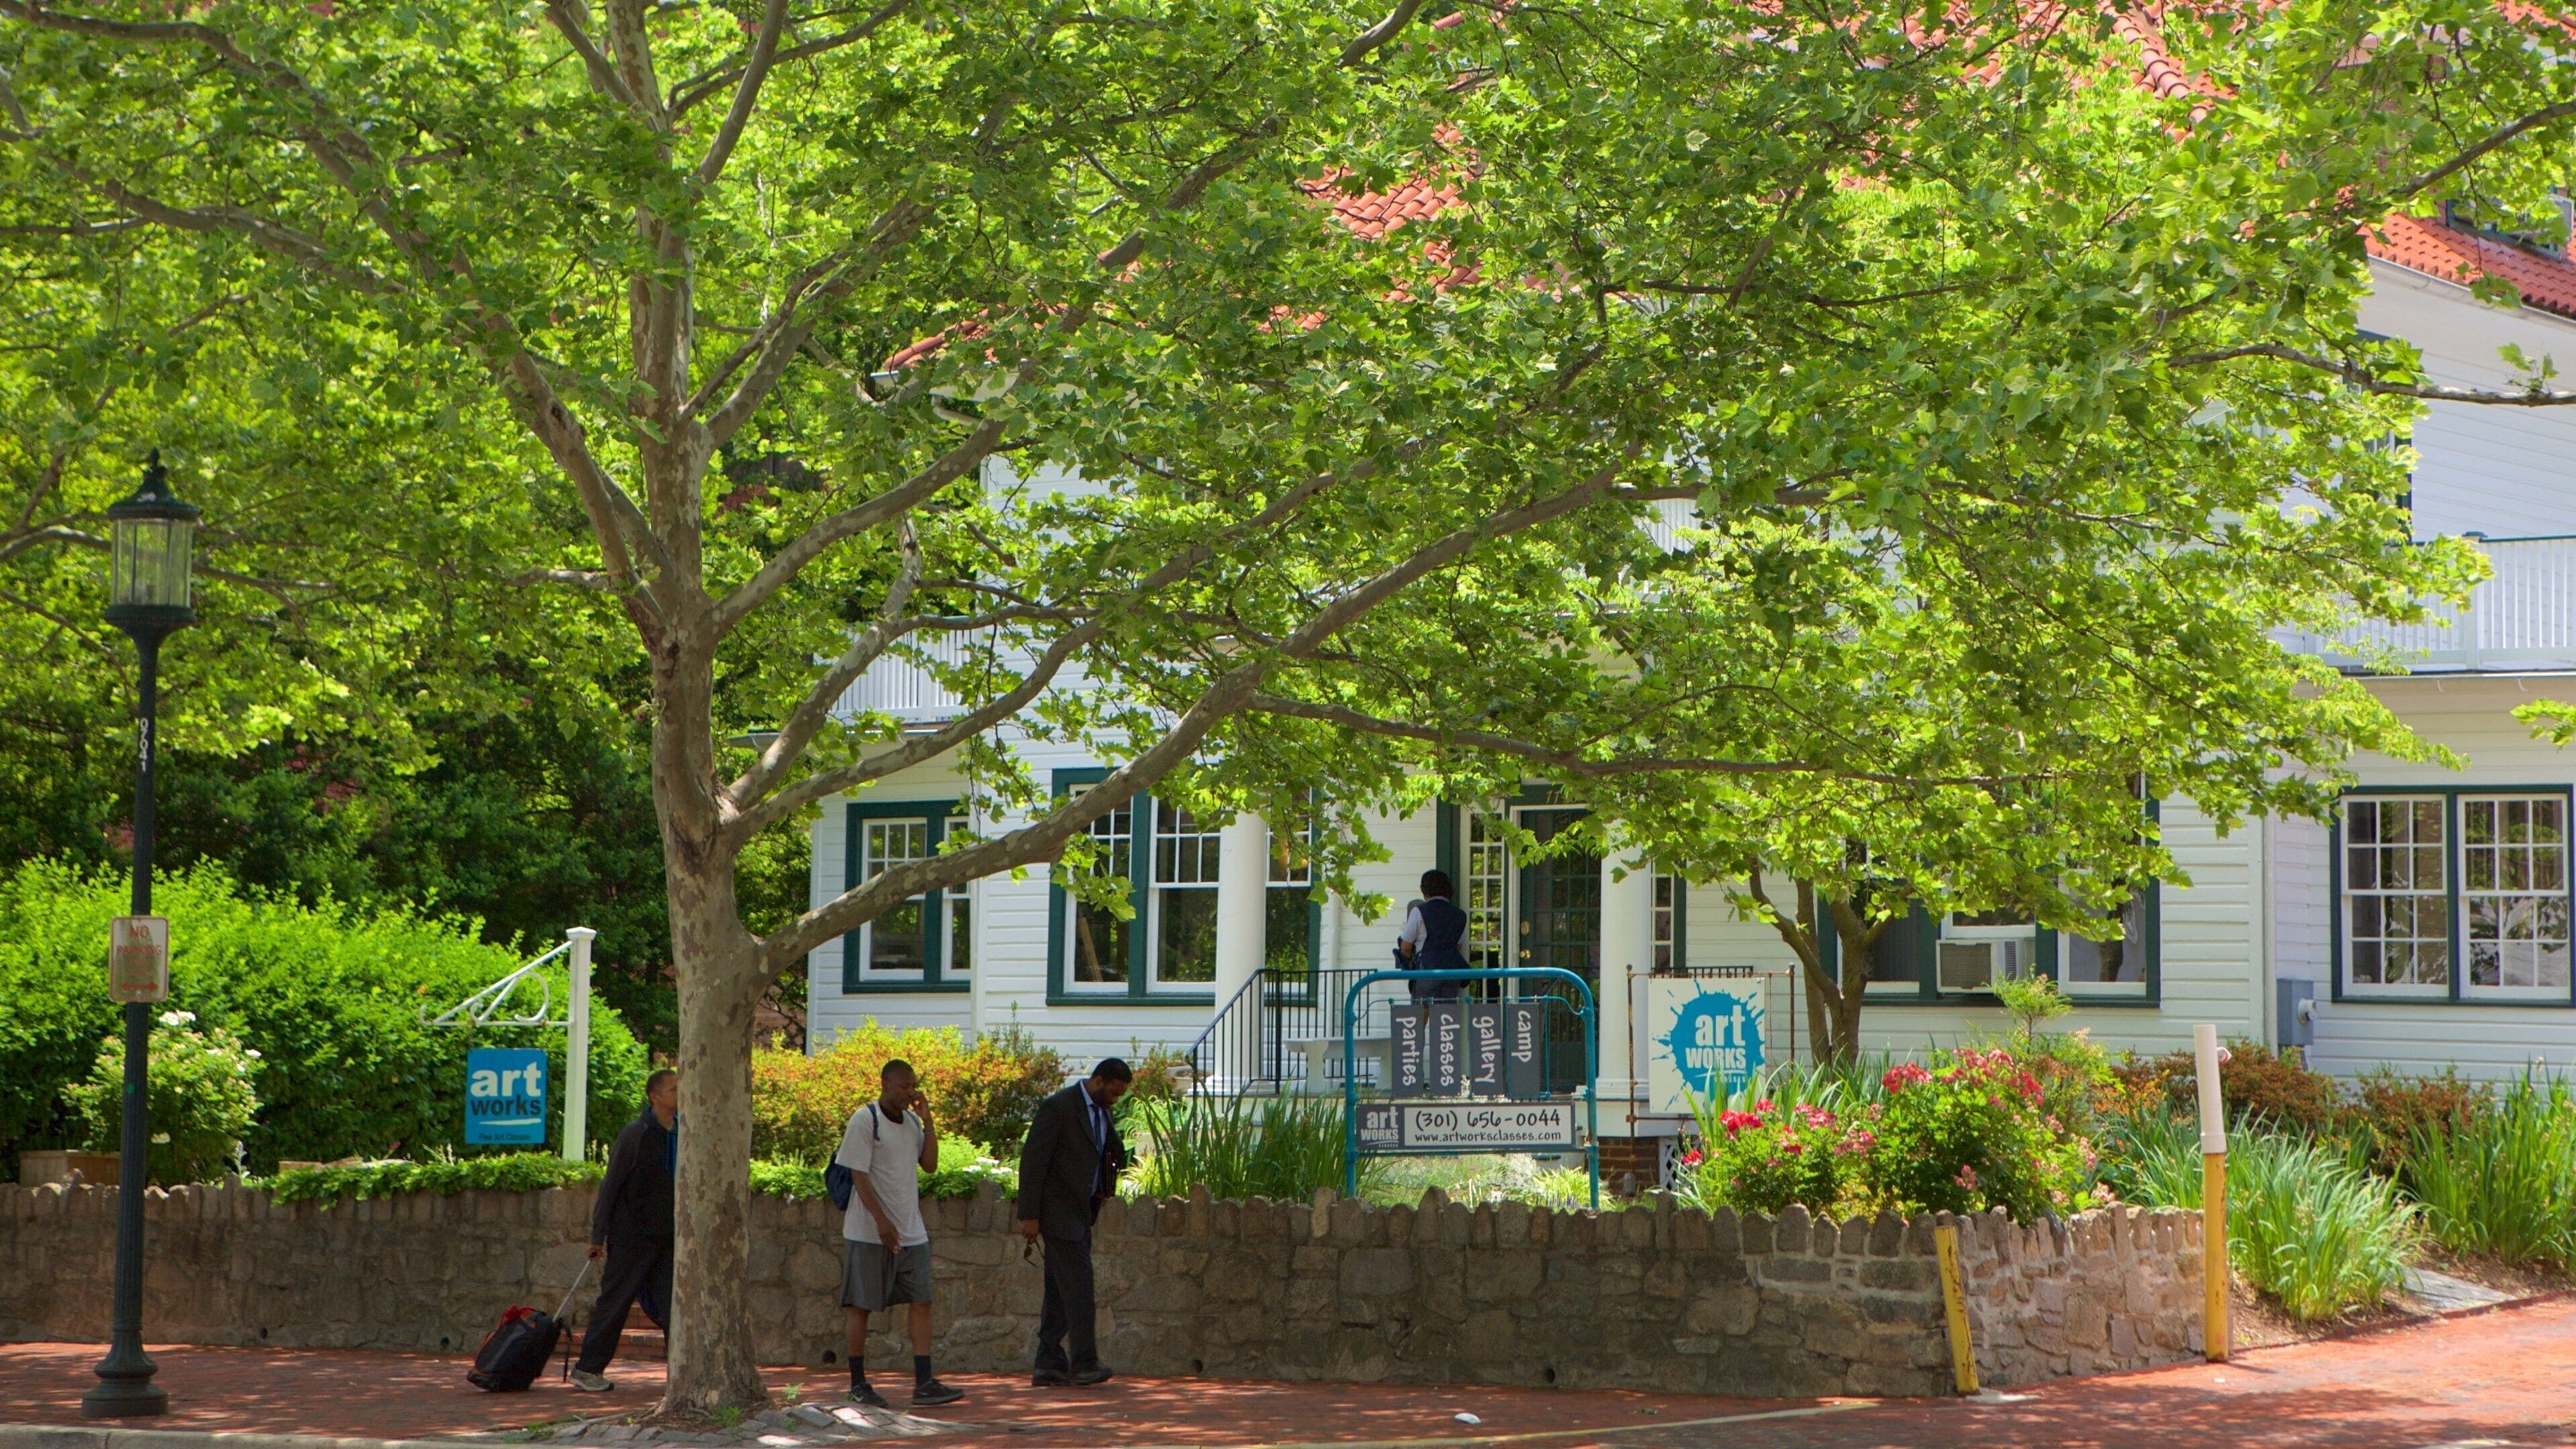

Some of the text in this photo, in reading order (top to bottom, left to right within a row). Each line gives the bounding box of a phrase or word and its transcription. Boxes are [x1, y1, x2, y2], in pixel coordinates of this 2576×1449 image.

[129, 925, 150, 938] NO
[1511, 1010, 1532, 1063] camp
[1695, 1005, 1746, 1046] art
[1395, 1016, 1420, 1087] parties
[1440, 1014, 1460, 1087] classes
[1472, 1016, 1501, 1083] gallery
[1685, 1047, 1746, 1069] WORKS
[470, 1061, 541, 1097] art
[470, 1095, 541, 1116] works
[1366, 1106, 1399, 1128] art
[1415, 1109, 1561, 1132] (301) 656-0044
[1360, 1128, 1399, 1141] WORKS
[1414, 1129, 1562, 1142] www.artworksclasses.com
